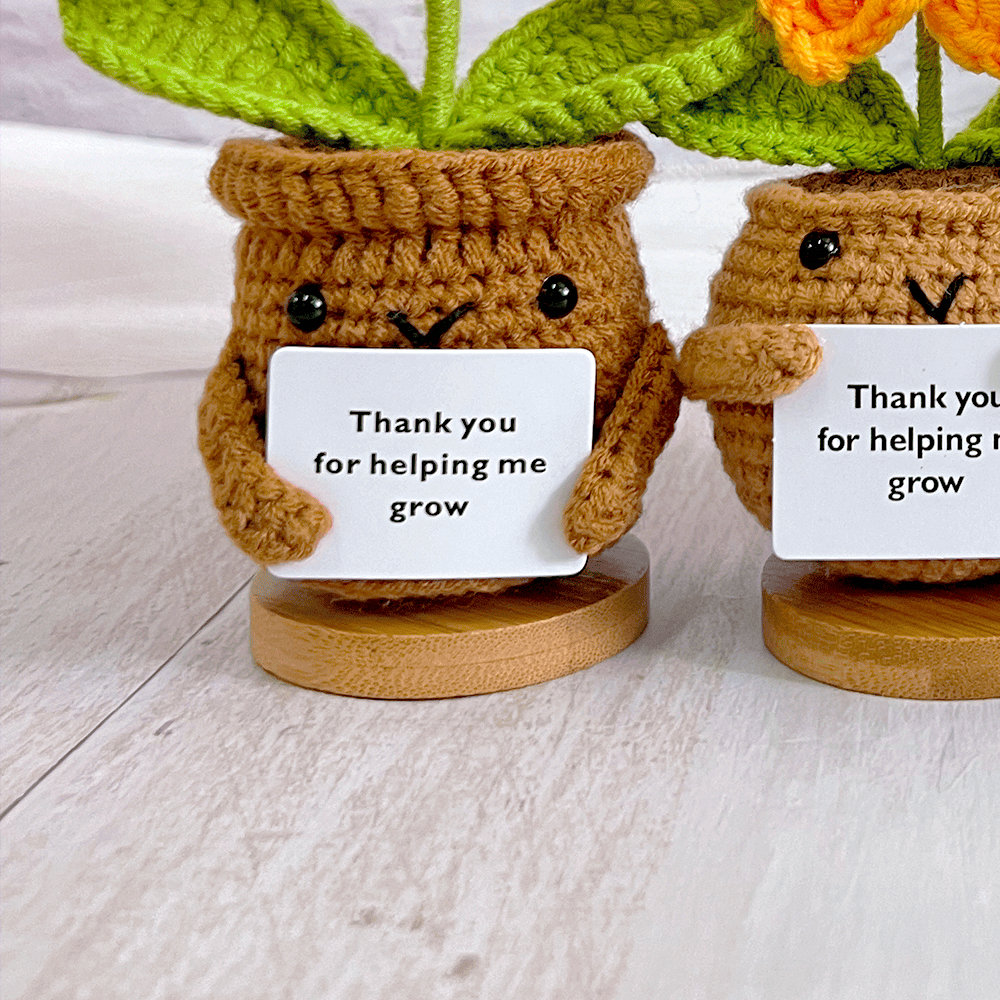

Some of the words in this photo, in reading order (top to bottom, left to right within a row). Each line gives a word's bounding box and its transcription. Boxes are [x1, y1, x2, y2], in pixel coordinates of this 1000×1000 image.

[847, 384, 947, 409] Thank
[349, 410, 452, 434] Thank
[461, 413, 516, 440] you
[817, 427, 860, 452] for
[870, 426, 982, 458] helping
[313, 452, 361, 475] for
[370, 452, 490, 481] helping
[498, 457, 547, 474] me
[888, 476, 965, 502] grow
[389, 501, 469, 524] grow
